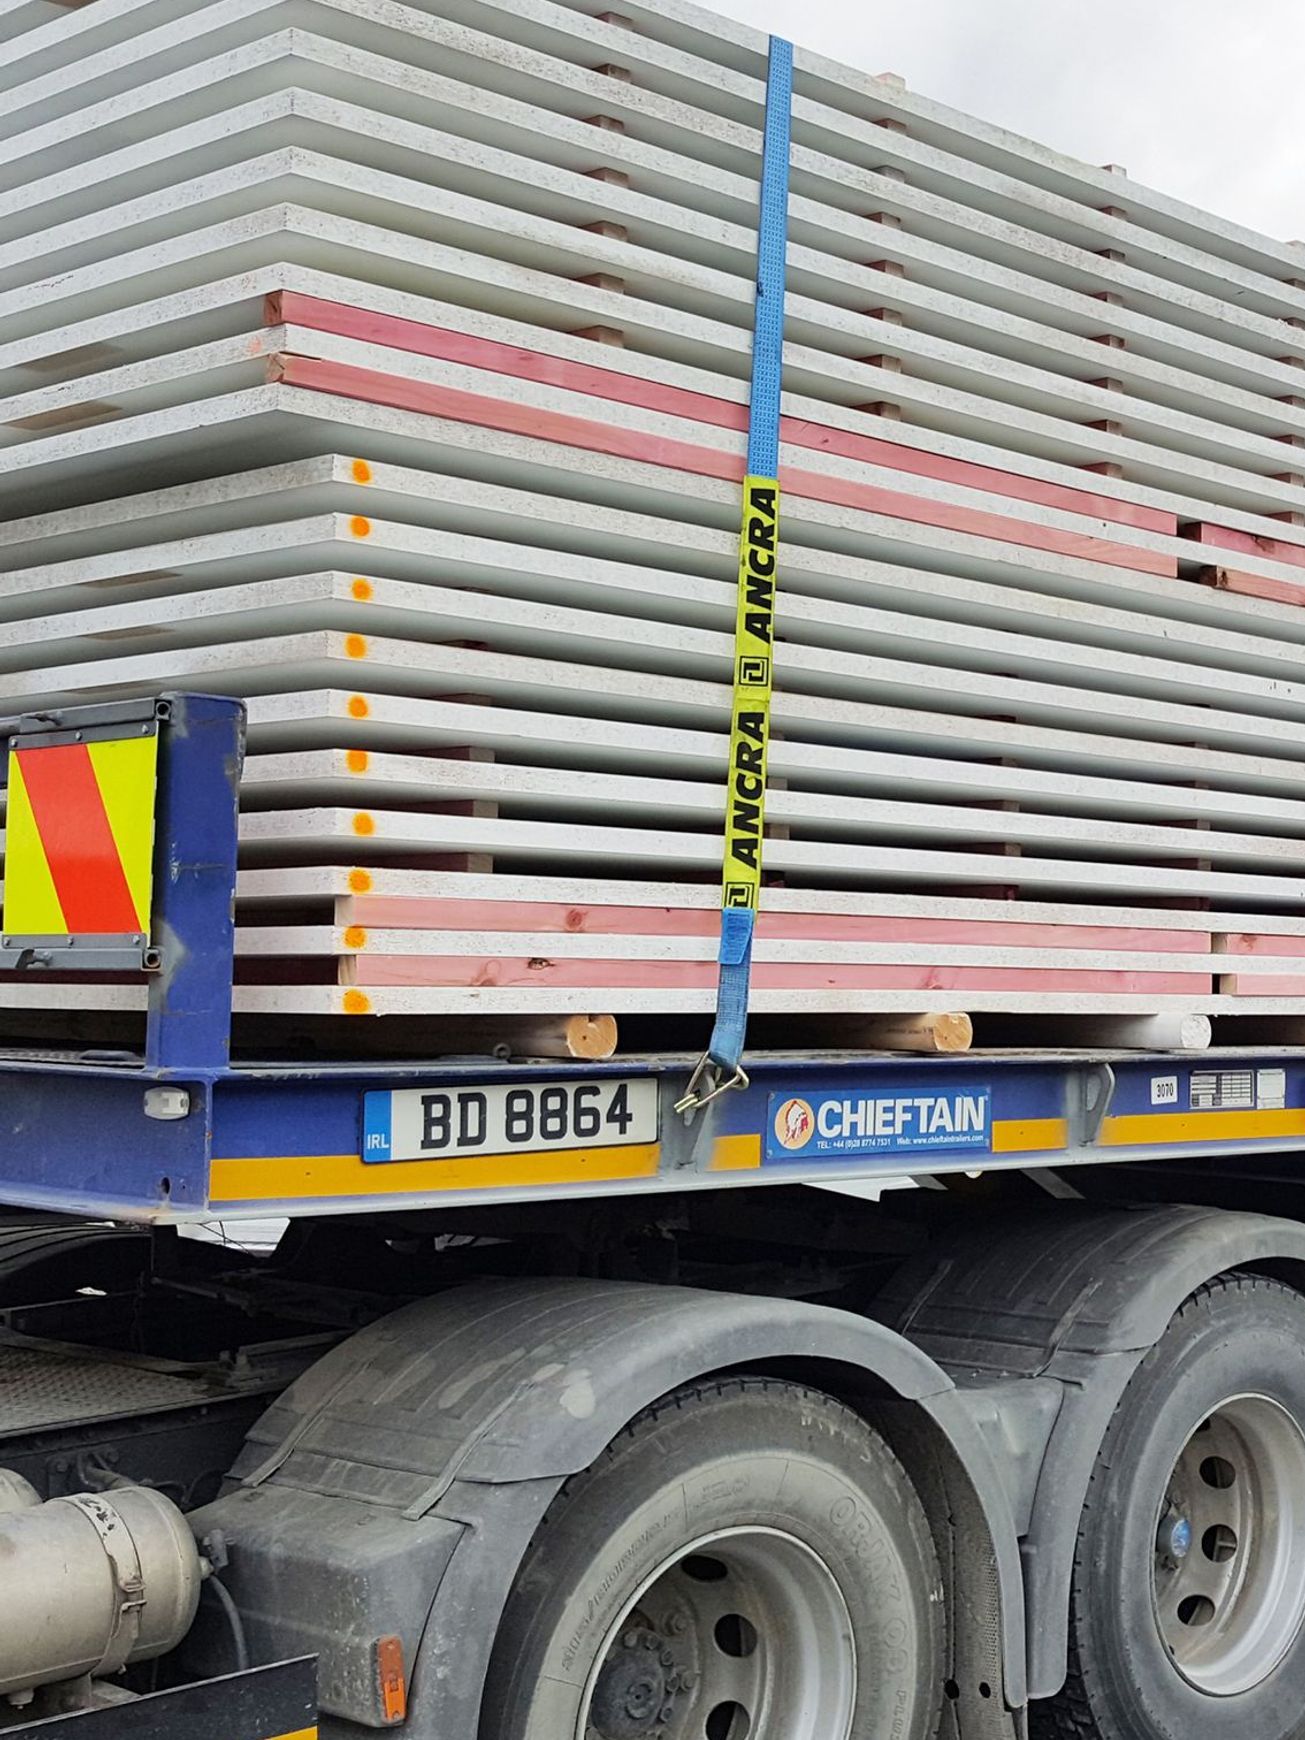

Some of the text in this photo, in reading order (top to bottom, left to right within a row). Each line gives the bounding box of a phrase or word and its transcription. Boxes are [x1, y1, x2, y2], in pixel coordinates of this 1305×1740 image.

[745, 488, 776, 644] ANCRA
[732, 712, 765, 870] ANCRA
[420, 1084, 633, 1150] BD 8864
[817, 1096, 985, 1138] CHIEFTAIN
[1156, 1083, 1174, 1098] 3070
[367, 1133, 390, 1150] IRL
